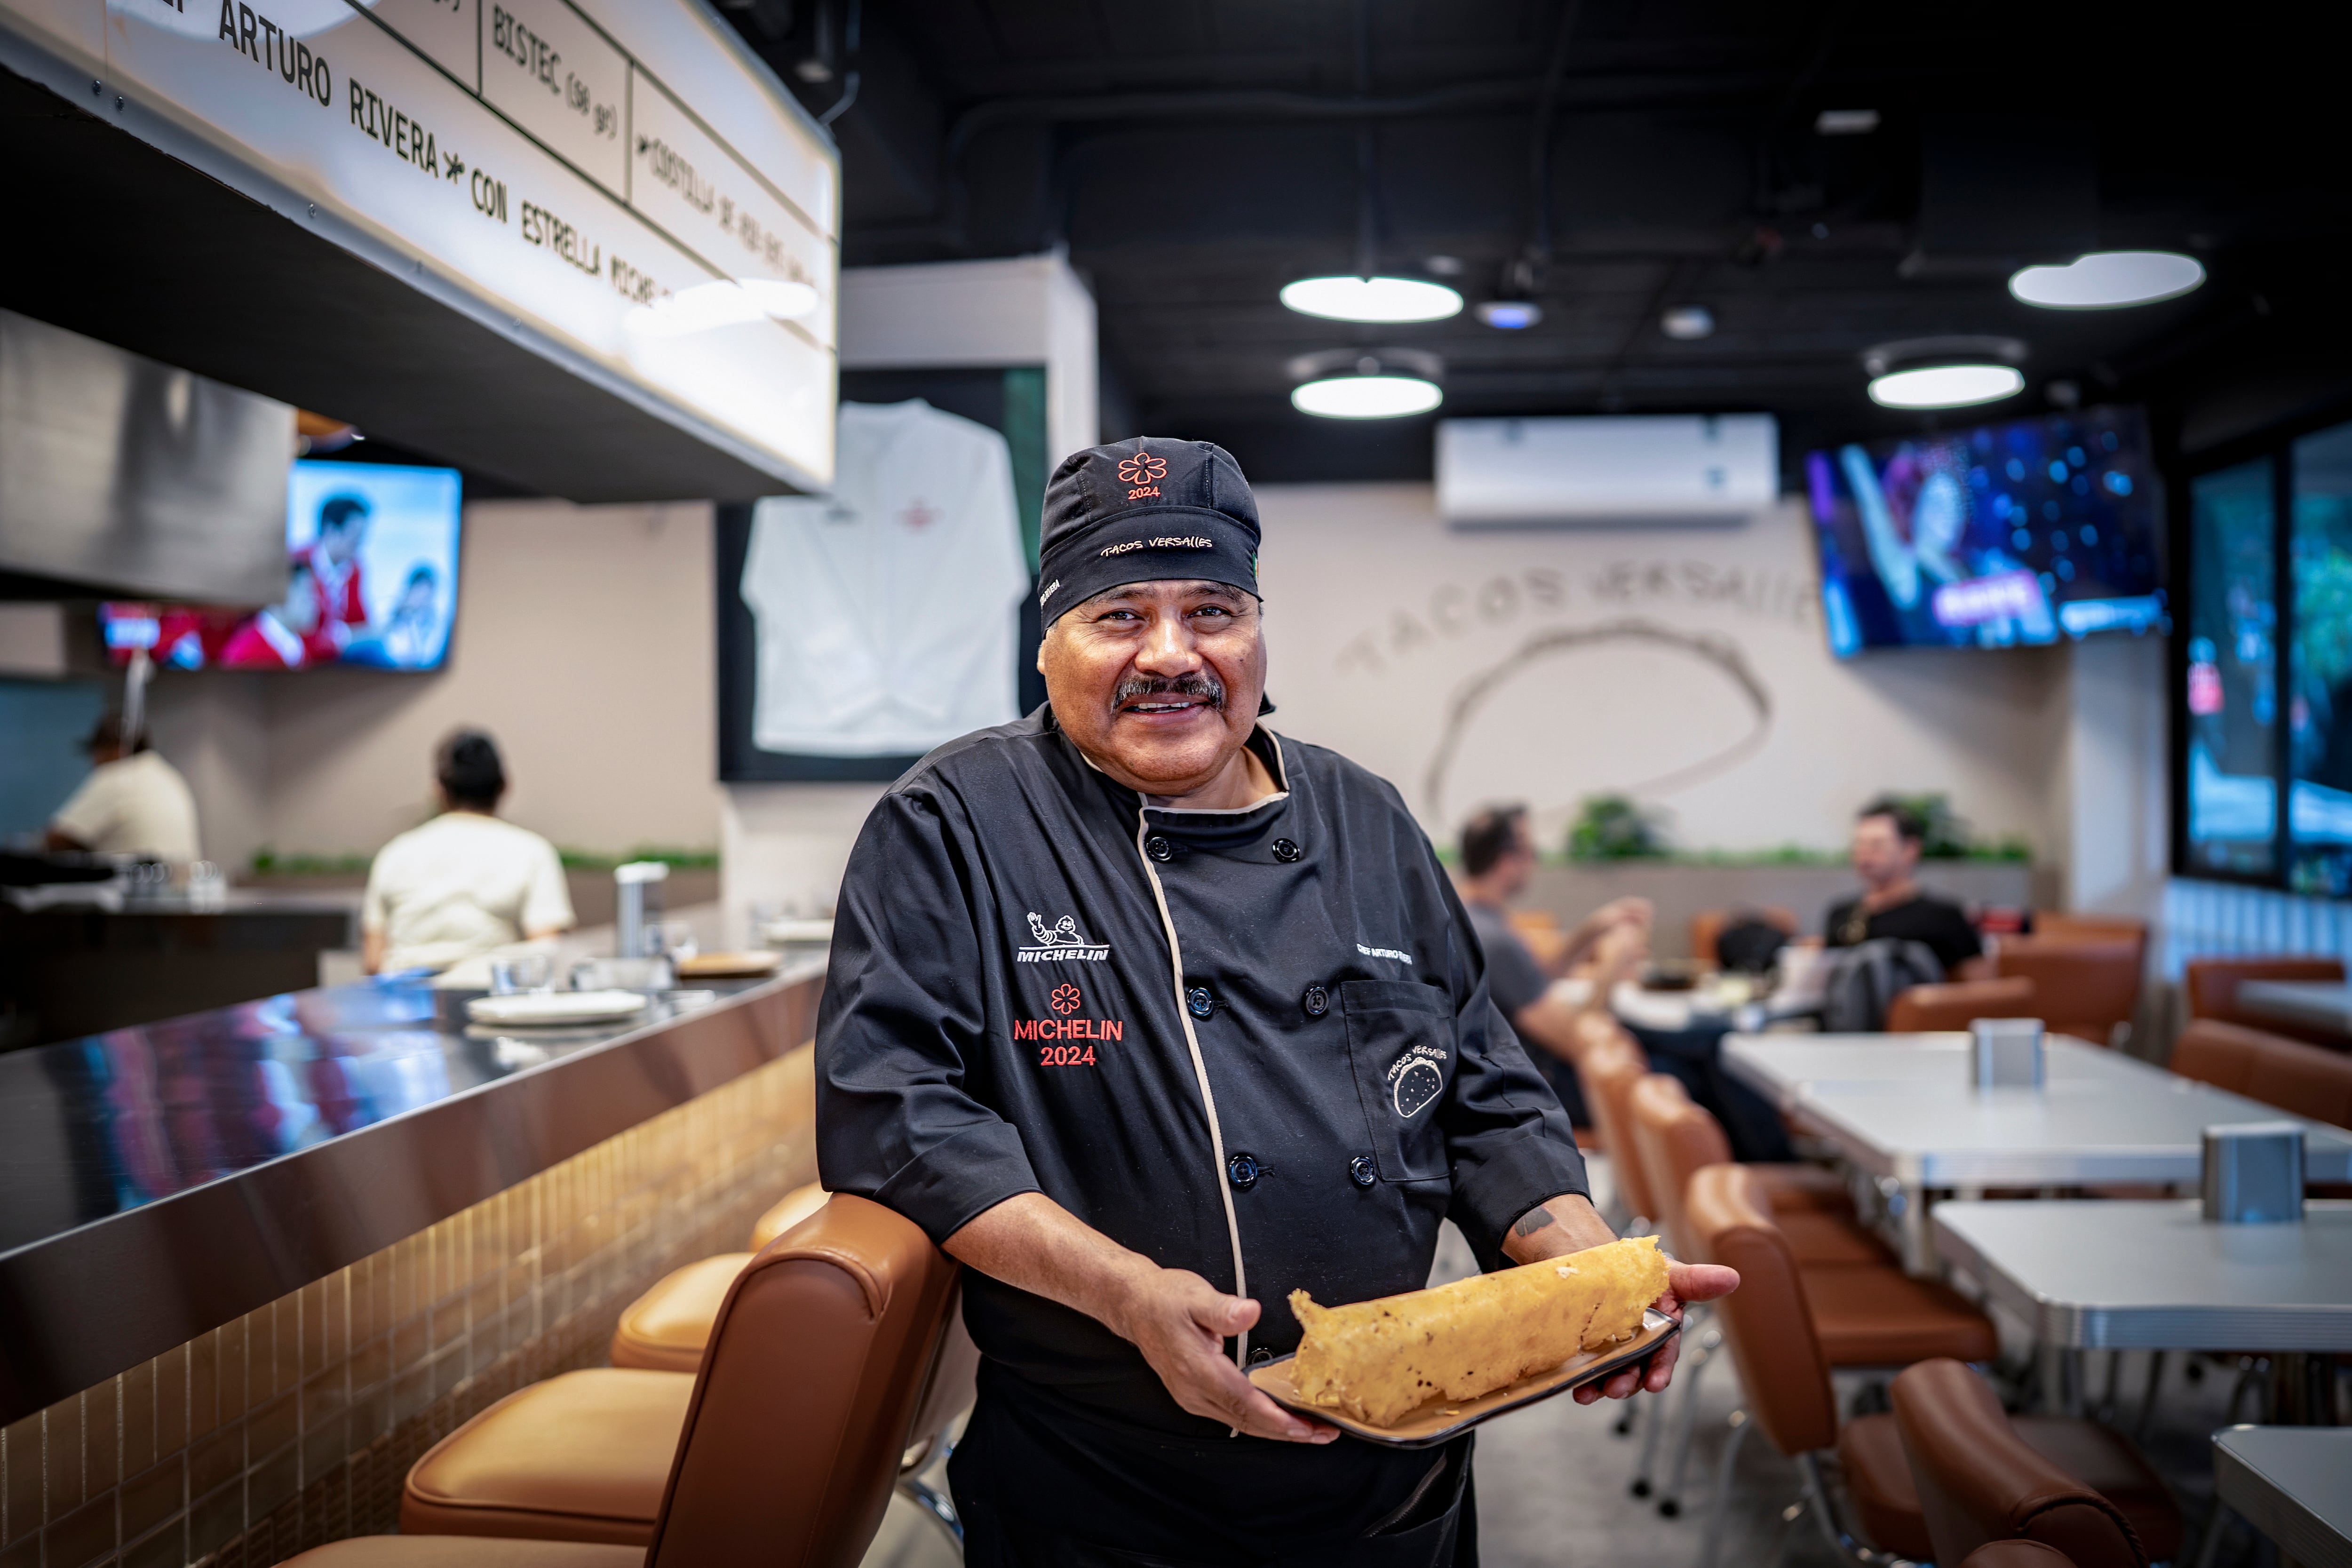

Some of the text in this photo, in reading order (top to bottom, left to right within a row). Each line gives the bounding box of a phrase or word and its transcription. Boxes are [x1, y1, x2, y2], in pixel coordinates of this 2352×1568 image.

[493, 4, 561, 95] BISTEC
[219, 0, 331, 107] ARTURO
[349, 76, 438, 178] RIVERA
[471, 168, 507, 223] CON
[521, 199, 600, 277] ESTRELLA
[1128, 486, 1161, 500] 2024
[1100, 541, 1144, 557] TACOS
[1017, 949, 1109, 963] MICHELIN
[1371, 948, 1398, 959] ARTURO
[1014, 1019, 1122, 1041] MICHELIN
[1041, 1046, 1096, 1066] 2024
[1387, 1053, 1412, 1081] TACOS
